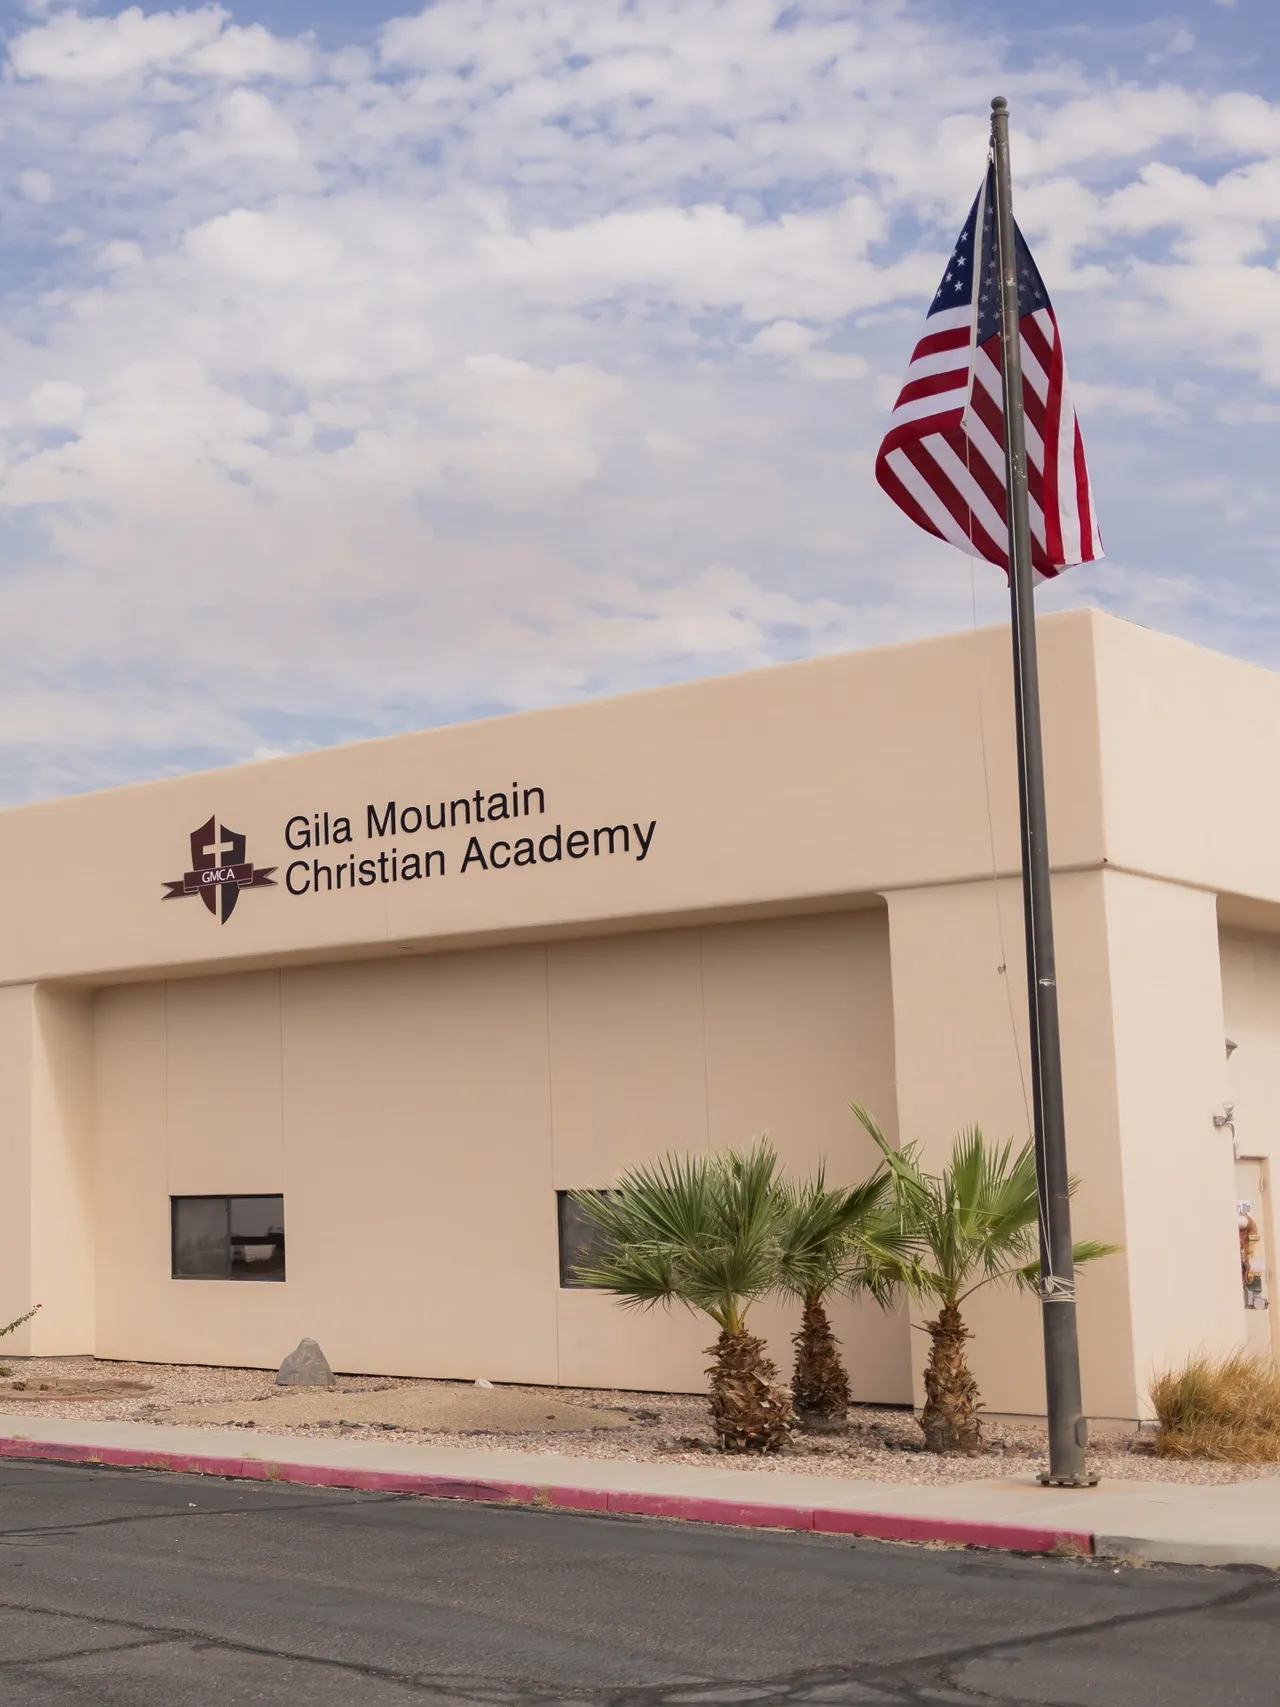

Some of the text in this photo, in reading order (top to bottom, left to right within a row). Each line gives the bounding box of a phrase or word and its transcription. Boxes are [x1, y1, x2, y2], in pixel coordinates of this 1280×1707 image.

[284, 781, 545, 851] Gila Mountain
[202, 868, 235, 883] GMCA
[285, 820, 657, 896] Christian Academy
